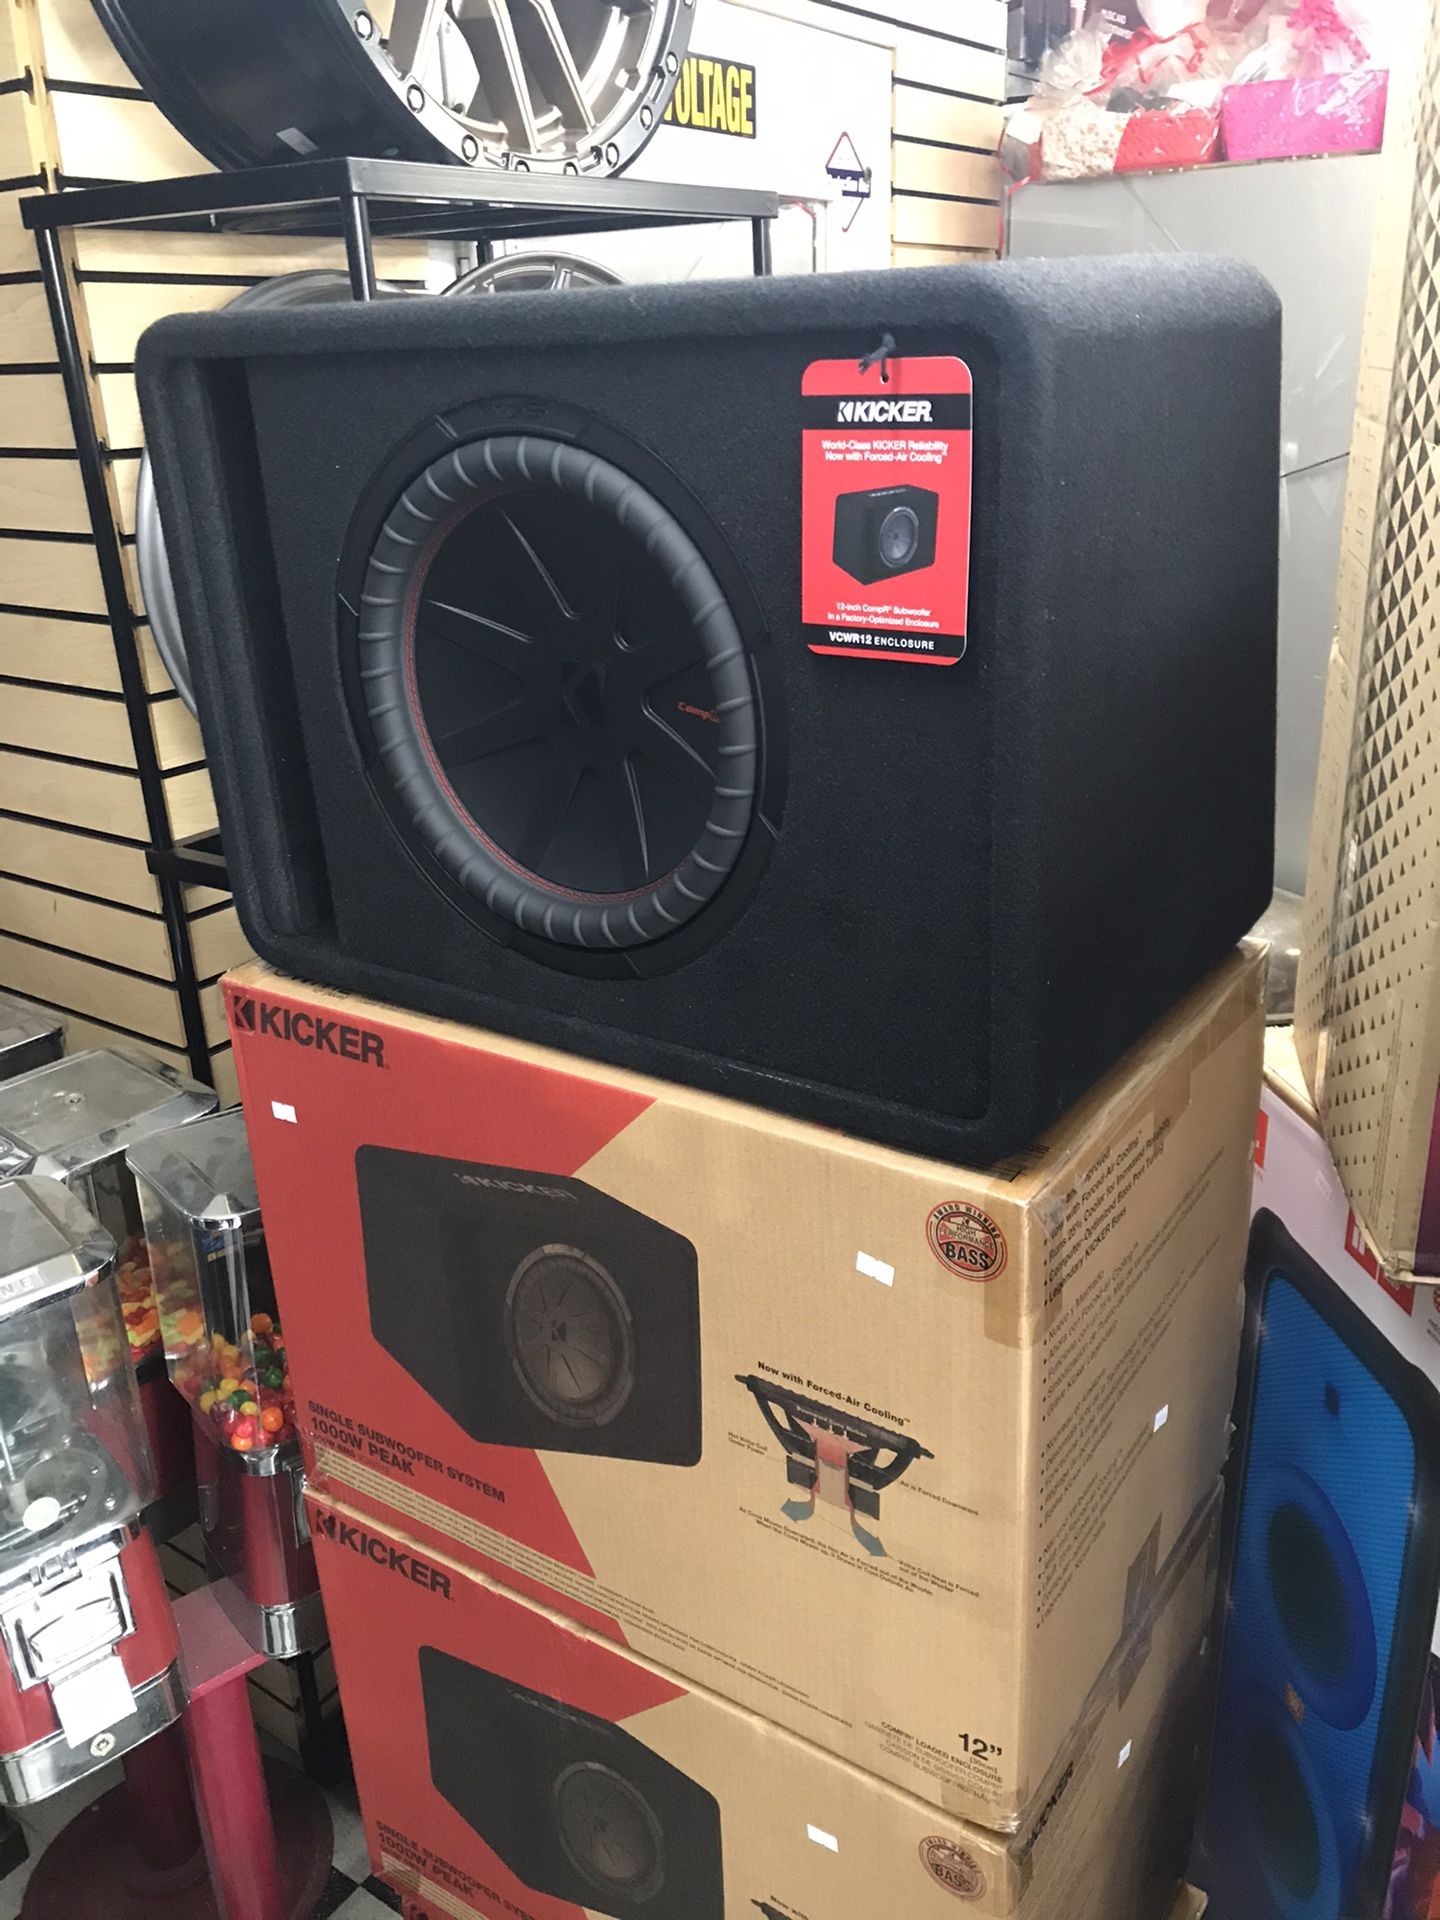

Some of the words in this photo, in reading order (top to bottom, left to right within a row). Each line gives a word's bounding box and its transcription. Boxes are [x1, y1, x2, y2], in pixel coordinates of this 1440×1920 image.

[663, 57, 753, 135] OLTAGE
[854, 401, 932, 422] KICKER
[822, 440, 871, 451] World-Class
[873, 440, 906, 451] KICKER
[908, 441, 949, 453] Reliability
[825, 452, 844, 462] Now
[845, 452, 862, 462] with
[864, 452, 907, 463] Forced-Air
[836, 602, 861, 613] 12-inch
[893, 606, 931, 618] Subwoofer
[841, 614, 904, 627] Factory-Optimized
[905, 618, 940, 629] Enclosure
[829, 631, 872, 646] VCWR12
[874, 637, 935, 651] ENCLOSURE
[260, 1002, 386, 1069] KICKER
[1084, 1191, 1105, 1223] Cooler
[1115, 1147, 1144, 1186] Increased
[933, 1203, 961, 1221] AWARD
[965, 1205, 1001, 1239] WINNING
[939, 1225, 994, 1249] PERFORMANCE
[956, 1225, 977, 1237] HIGH
[946, 1242, 989, 1269] BASS
[1049, 1255, 1083, 1303] Legendary
[1084, 1222, 1110, 1260] KICKER
[1111, 1203, 1127, 1229] Bass
[758, 1361, 779, 1376] Now
[782, 1372, 804, 1386] with
[807, 1380, 861, 1408] Forced-Air
[309, 1400, 354, 1431] SINGLE
[357, 1423, 444, 1473] SUBWOOFER
[446, 1465, 506, 1503] SYSTEM
[311, 1416, 362, 1451] 1000W
[367, 1442, 416, 1478] PEAK
[340, 1521, 451, 1601] KICKER
[915, 1738, 950, 1760] LOADED
[950, 1755, 1003, 1784] ENCLOSURE
[376, 1820, 419, 1850] SINGLE
[422, 1847, 502, 1904] SUBWOOFER
[378, 1833, 428, 1868] 1000W
[431, 1864, 475, 1898] PEAK
